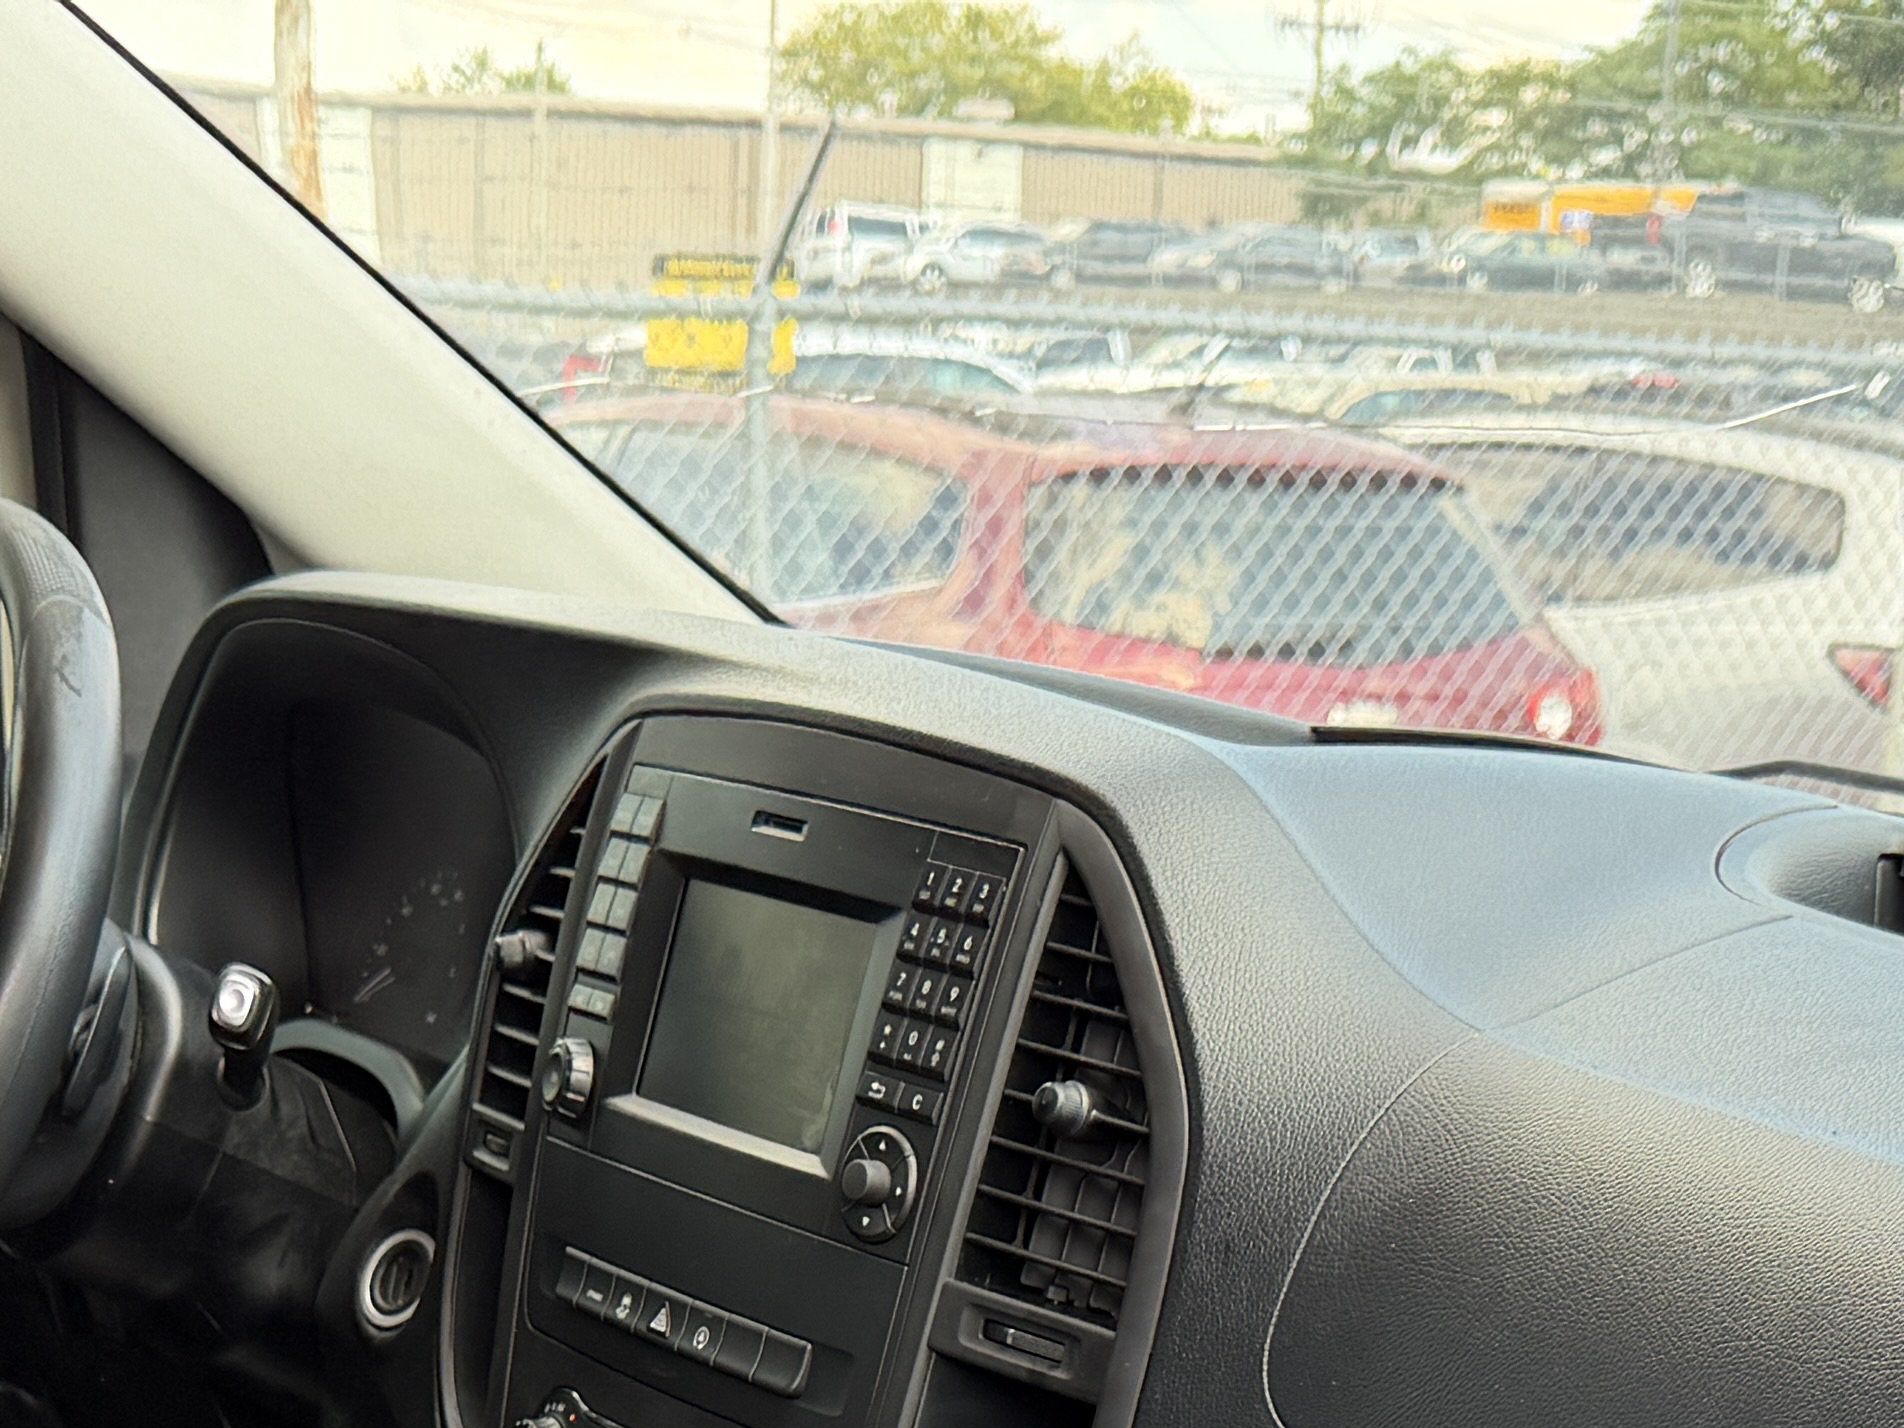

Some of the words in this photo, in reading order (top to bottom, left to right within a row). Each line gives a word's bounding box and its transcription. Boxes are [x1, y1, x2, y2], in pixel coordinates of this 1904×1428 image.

[952, 877, 963, 893] 2
[979, 883, 989, 899] 3
[963, 935, 973, 950] 6
[896, 972, 907, 986] 7
[921, 979, 932, 995] 8
[949, 986, 959, 1002] 9
[908, 1030, 918, 1046] 0
[912, 1094, 923, 1110] C
